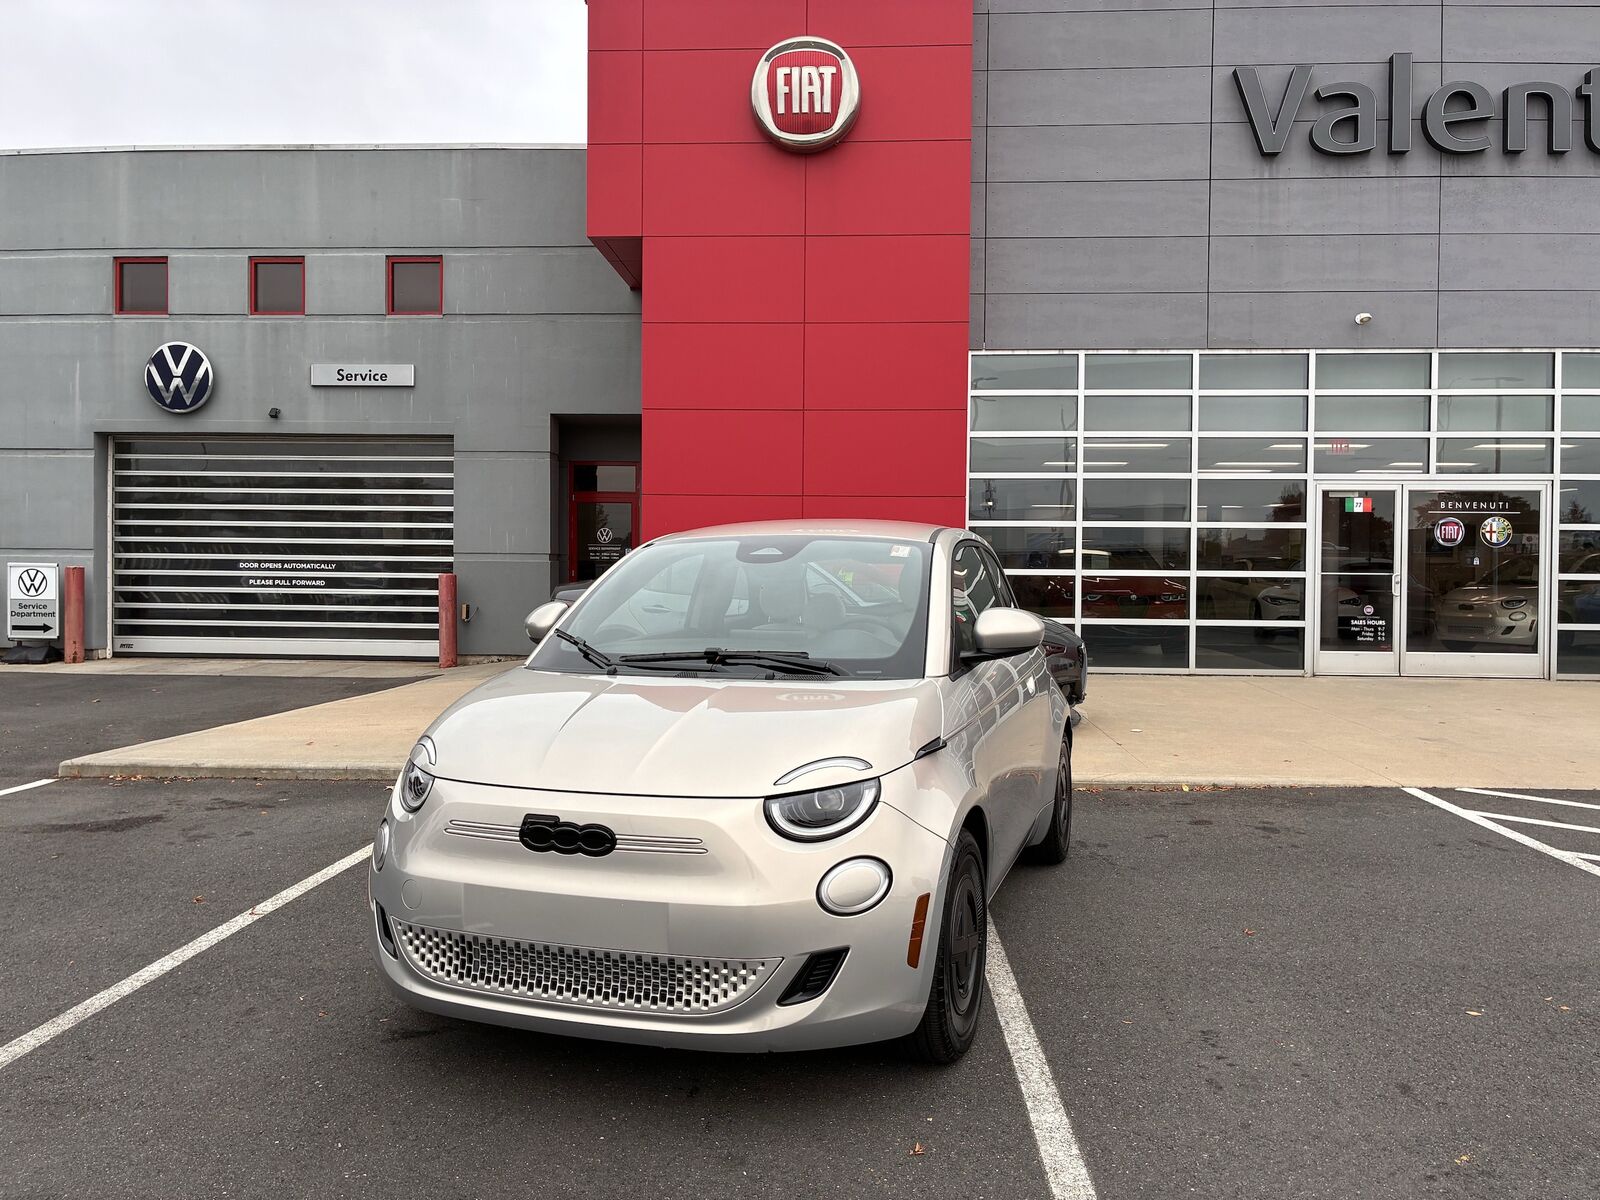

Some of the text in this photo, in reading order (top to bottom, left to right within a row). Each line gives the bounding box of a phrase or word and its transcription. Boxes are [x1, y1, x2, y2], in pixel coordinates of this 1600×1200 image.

[776, 65, 837, 115] FIAT
[336, 368, 389, 383] Service
[1440, 501, 1509, 509] BENVENUTI
[1441, 525, 1459, 539] FIAT
[18, 602, 48, 610] Service
[10, 610, 56, 618] Department
[519, 813, 617, 858] 500
